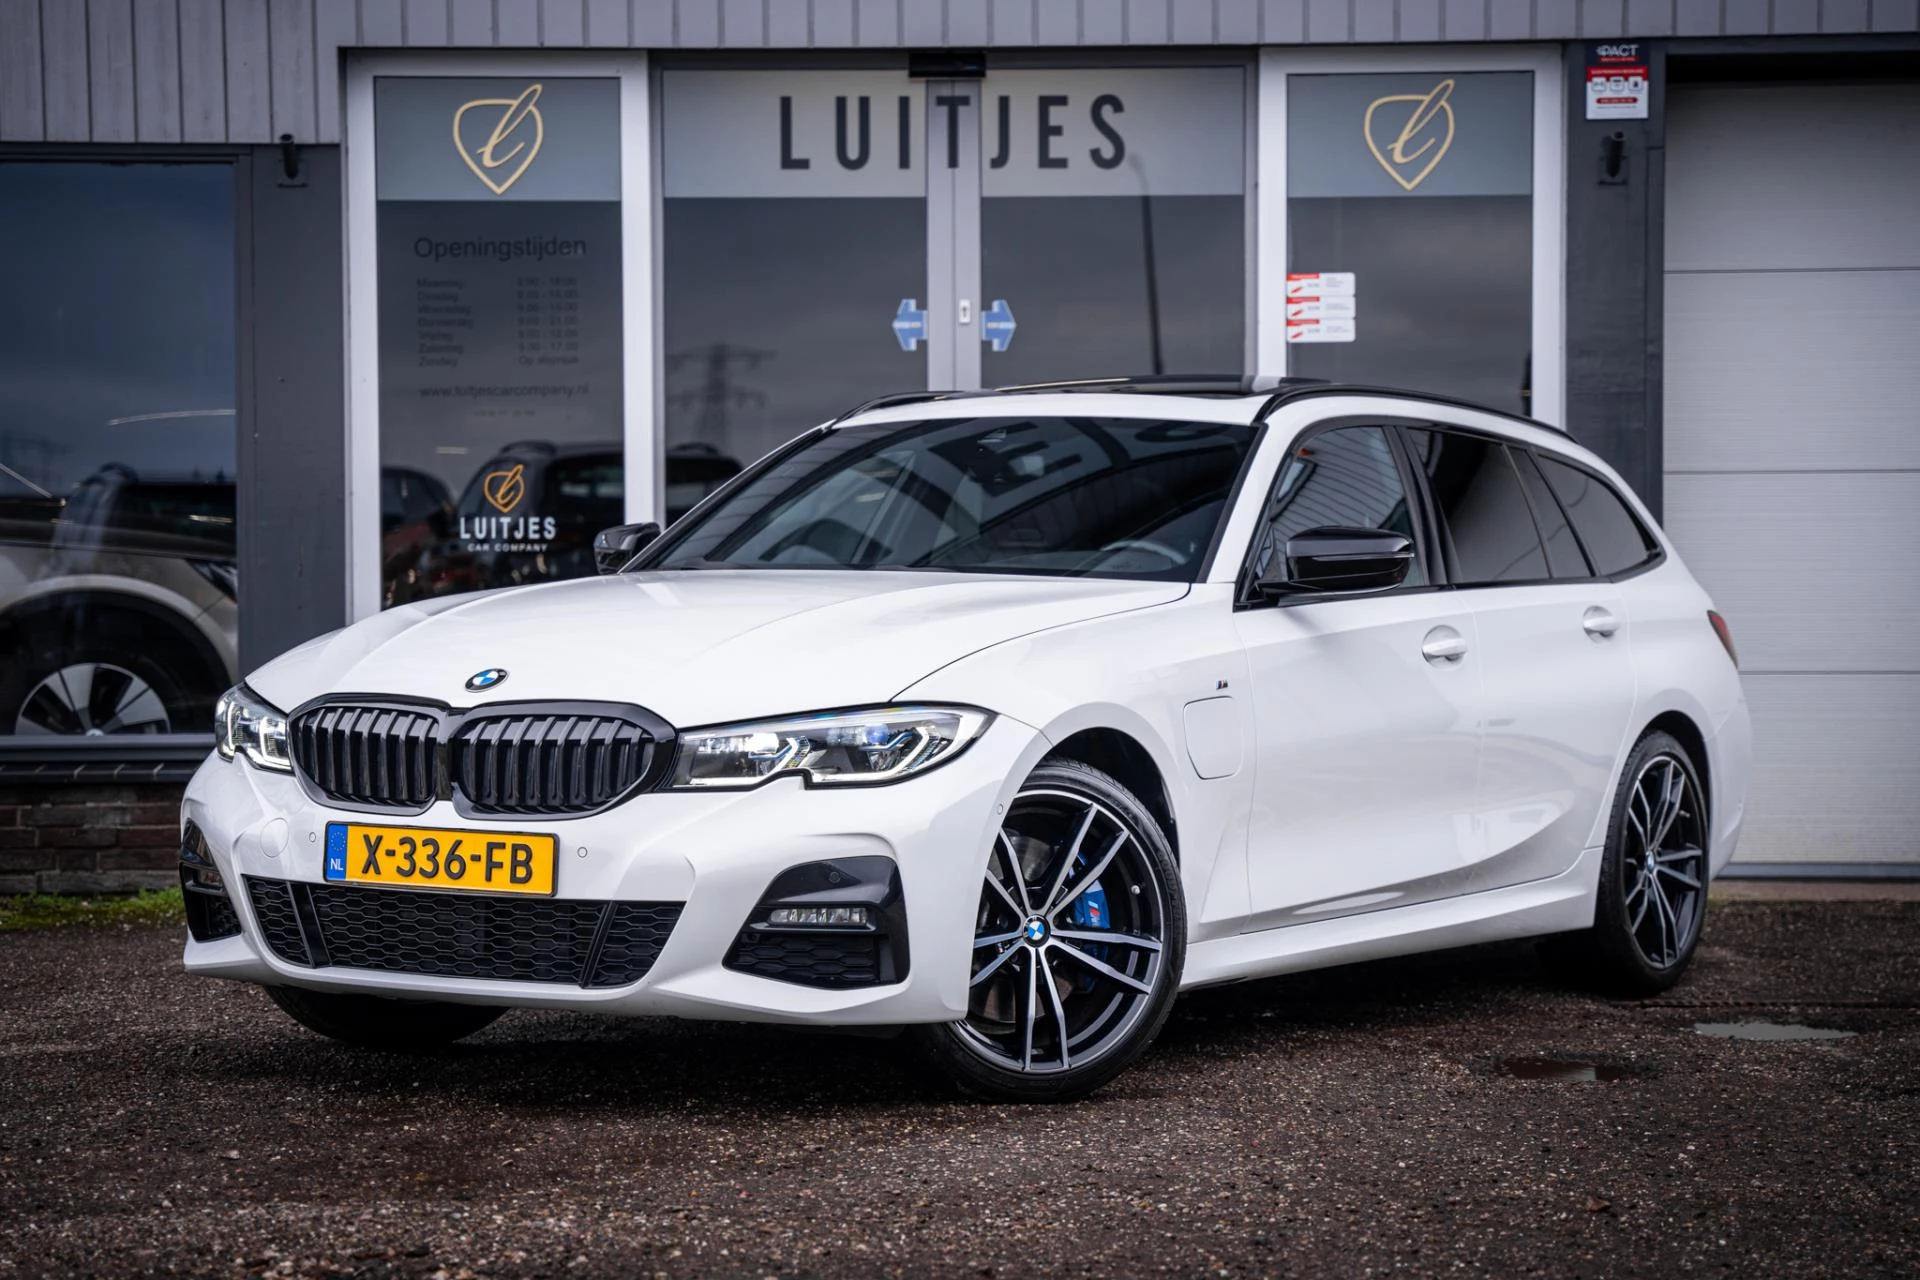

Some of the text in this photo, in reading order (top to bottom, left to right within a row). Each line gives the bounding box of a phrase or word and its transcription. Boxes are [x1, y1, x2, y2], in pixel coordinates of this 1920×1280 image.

[780, 94, 1125, 170] LUITJES
[414, 236, 586, 262] Openingstijden
[460, 516, 556, 539] LUITJES
[467, 543, 548, 552] CAR COMPANY
[330, 858, 344, 871] NL
[361, 834, 533, 885] X-336-FB
